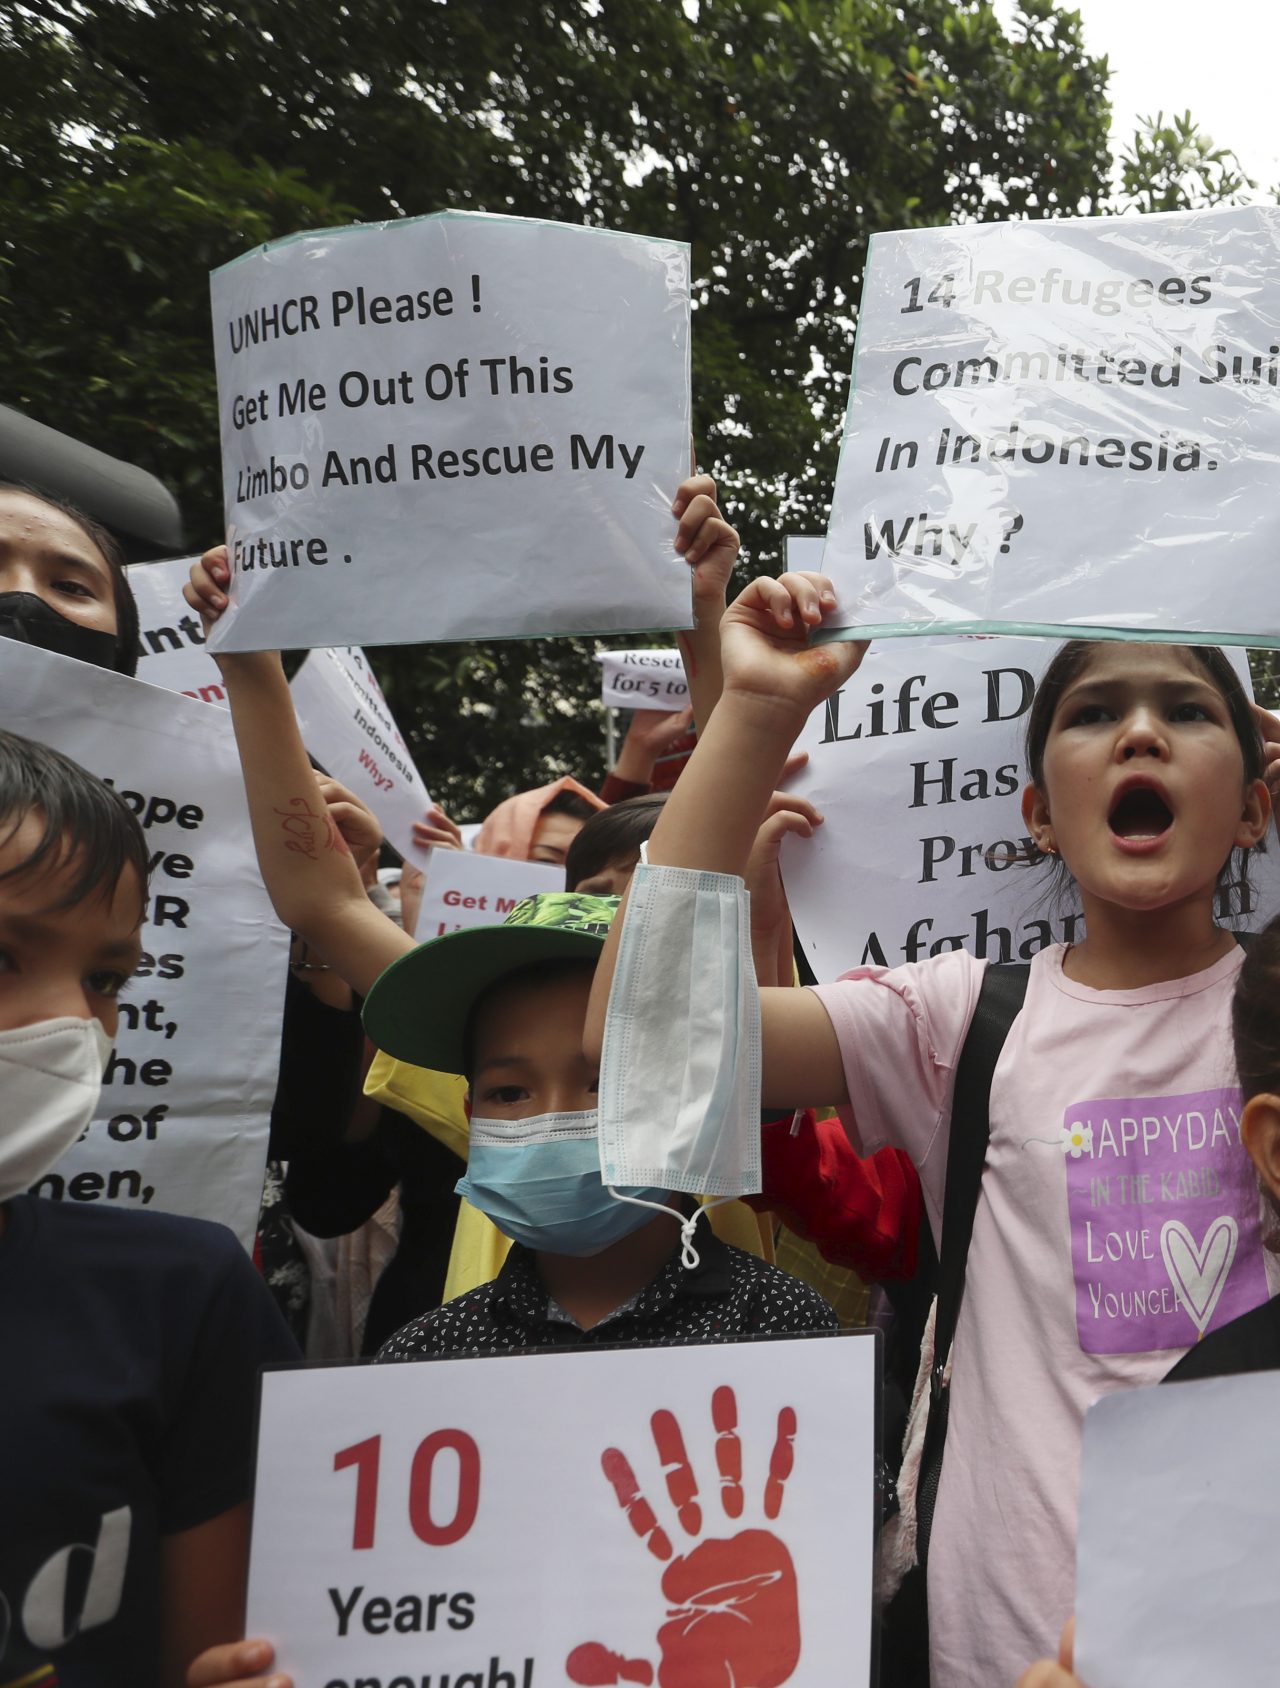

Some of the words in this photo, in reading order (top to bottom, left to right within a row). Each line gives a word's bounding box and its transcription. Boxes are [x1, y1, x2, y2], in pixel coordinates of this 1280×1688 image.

[900, 273, 956, 314] 14
[973, 267, 1212, 317] Refugees
[229, 295, 320, 355] UNHCR
[332, 285, 454, 327] Please
[232, 389, 269, 431] Get
[277, 378, 326, 415] Me
[338, 370, 413, 409] Out
[424, 359, 471, 400] Of
[480, 355, 574, 396] This
[892, 345, 1181, 396] Committed
[236, 456, 310, 504] Limbo
[321, 444, 397, 488] And
[411, 441, 554, 480] Rescue
[570, 433, 646, 479] My
[875, 436, 918, 473] In
[936, 424, 1219, 473] Indonesia.
[234, 538, 328, 573] Future
[863, 513, 977, 566] Why
[612, 673, 645, 692] for
[648, 682, 660, 696] 5
[819, 675, 960, 745] Life
[353, 709, 413, 783] Indonesia
[358, 748, 394, 792] Why?
[103, 778, 204, 830] ope
[908, 757, 1020, 810] Has
[442, 890, 488, 910] Get
[107, 1104, 169, 1141] of
[332, 1427, 483, 1551] 10
[328, 1586, 475, 1636] Years
